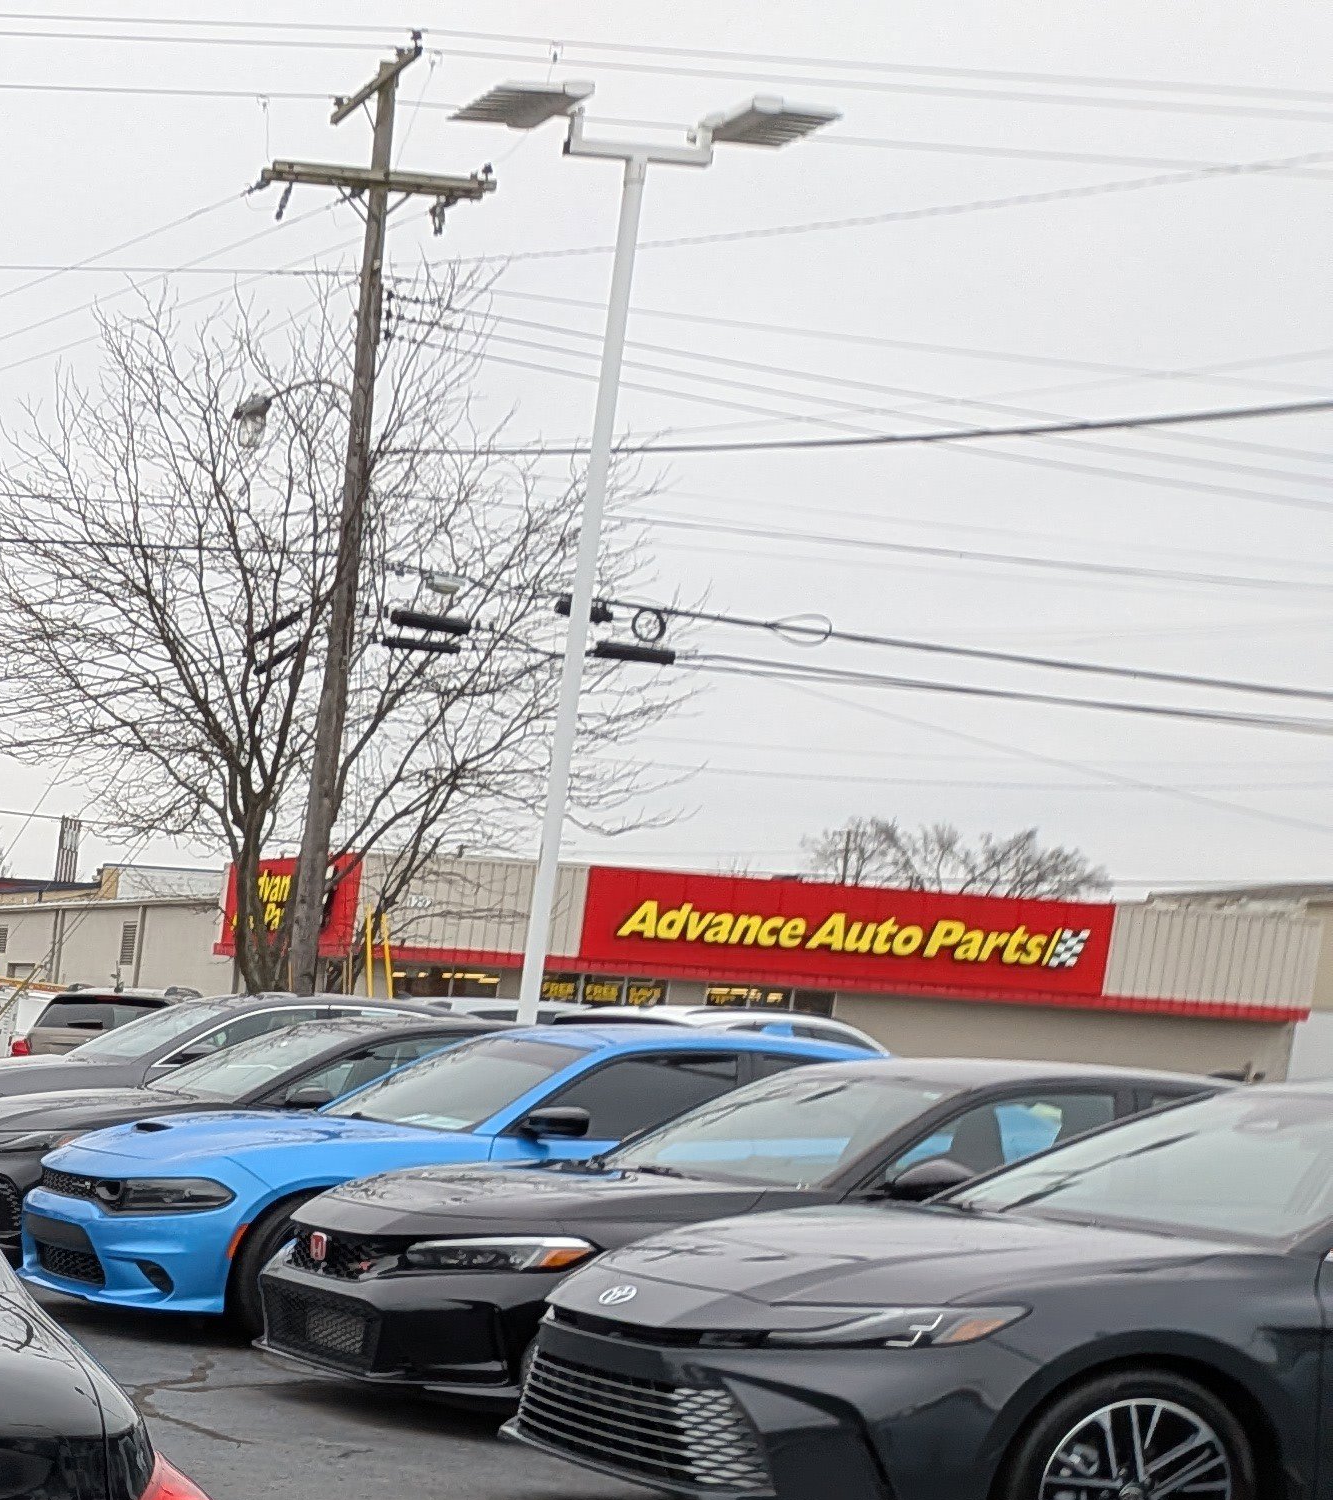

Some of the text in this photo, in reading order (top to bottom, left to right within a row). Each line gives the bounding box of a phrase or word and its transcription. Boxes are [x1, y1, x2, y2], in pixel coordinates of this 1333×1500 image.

[617, 900, 1048, 965] Advance Auto Parts
